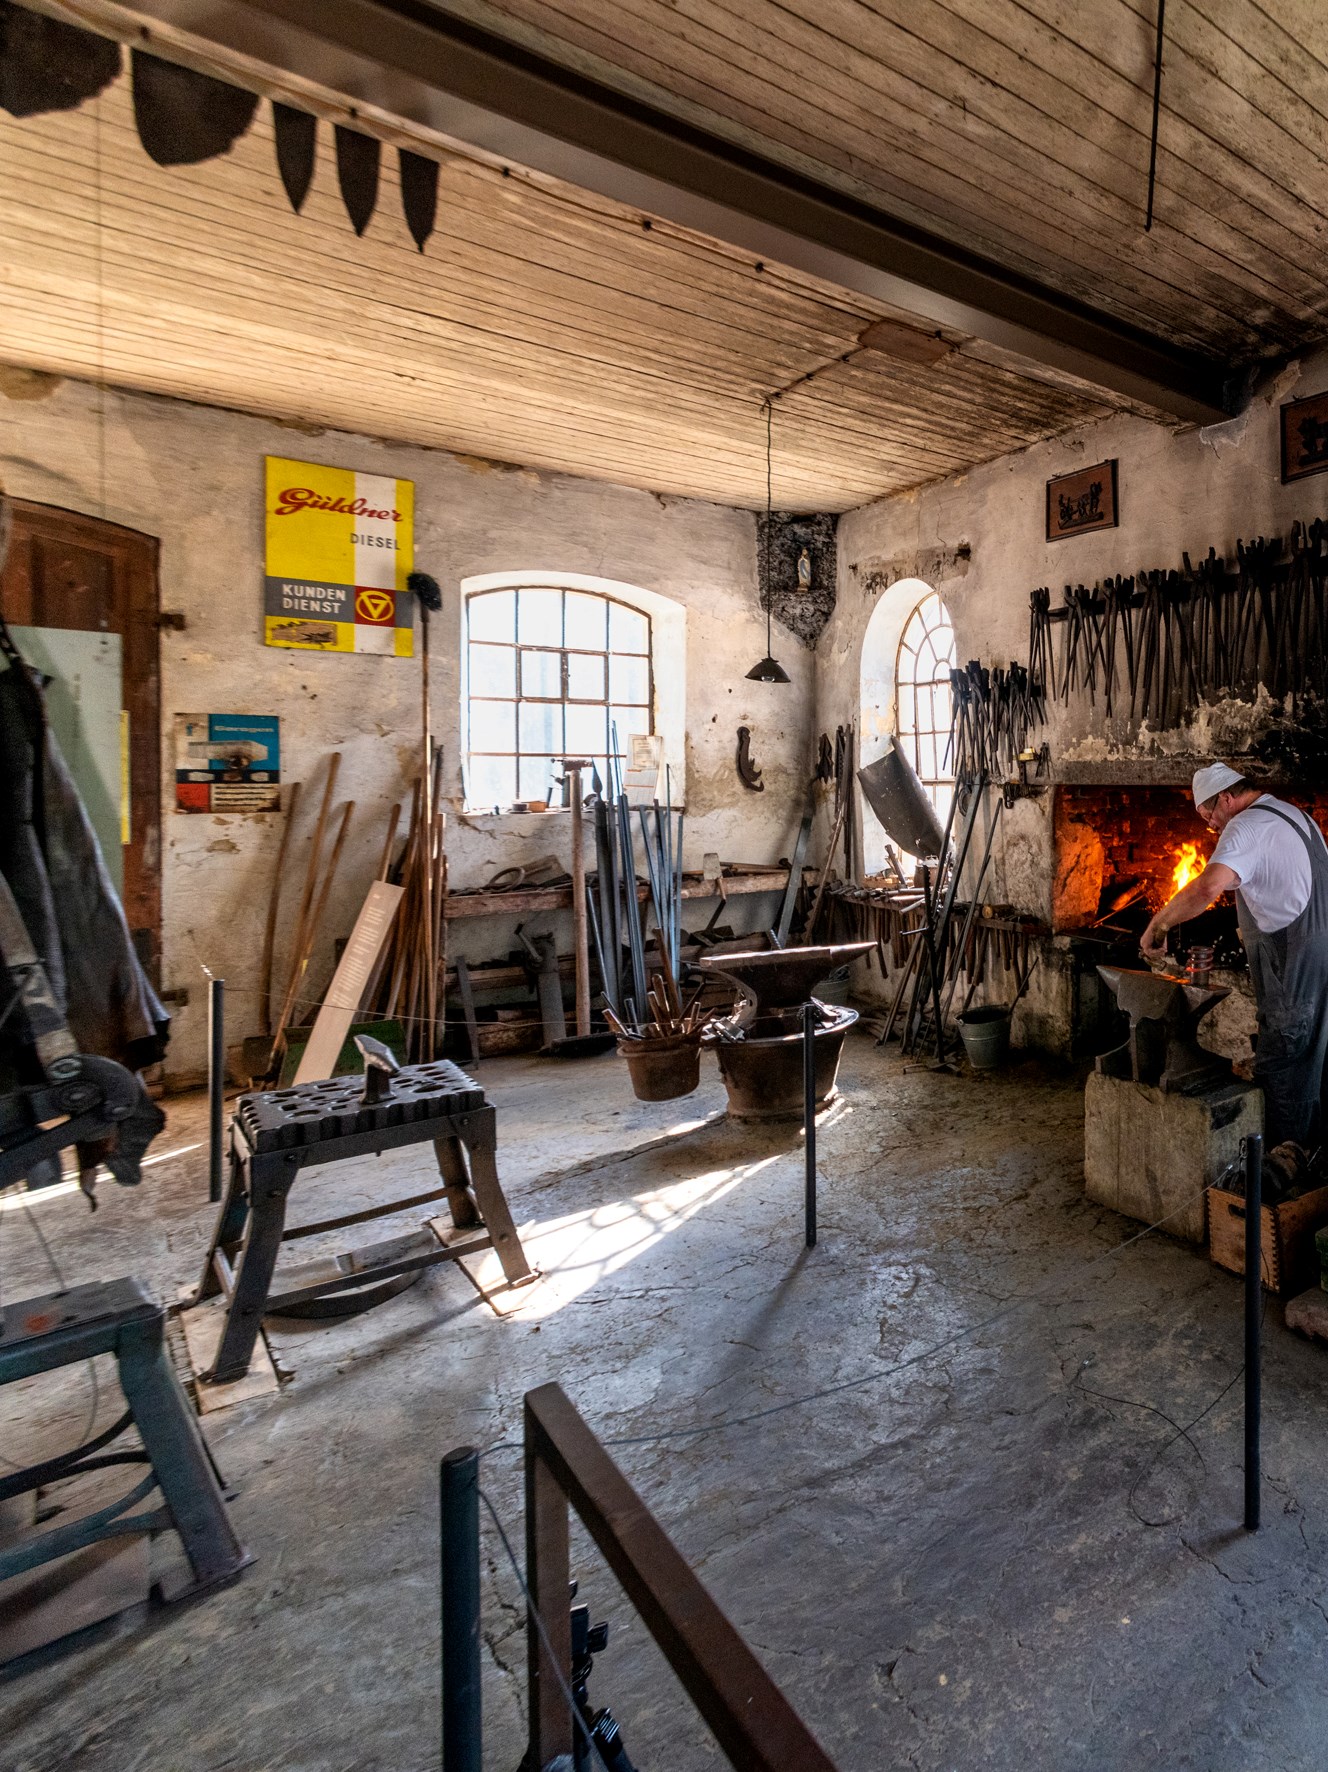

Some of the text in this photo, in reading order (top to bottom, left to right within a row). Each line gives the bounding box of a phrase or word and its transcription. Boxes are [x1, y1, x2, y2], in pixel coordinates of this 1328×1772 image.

[274, 487, 403, 522] Güldner
[350, 532, 401, 550] DIESEL
[282, 583, 346, 601] KUNDEN
[283, 597, 342, 614] DIENST
